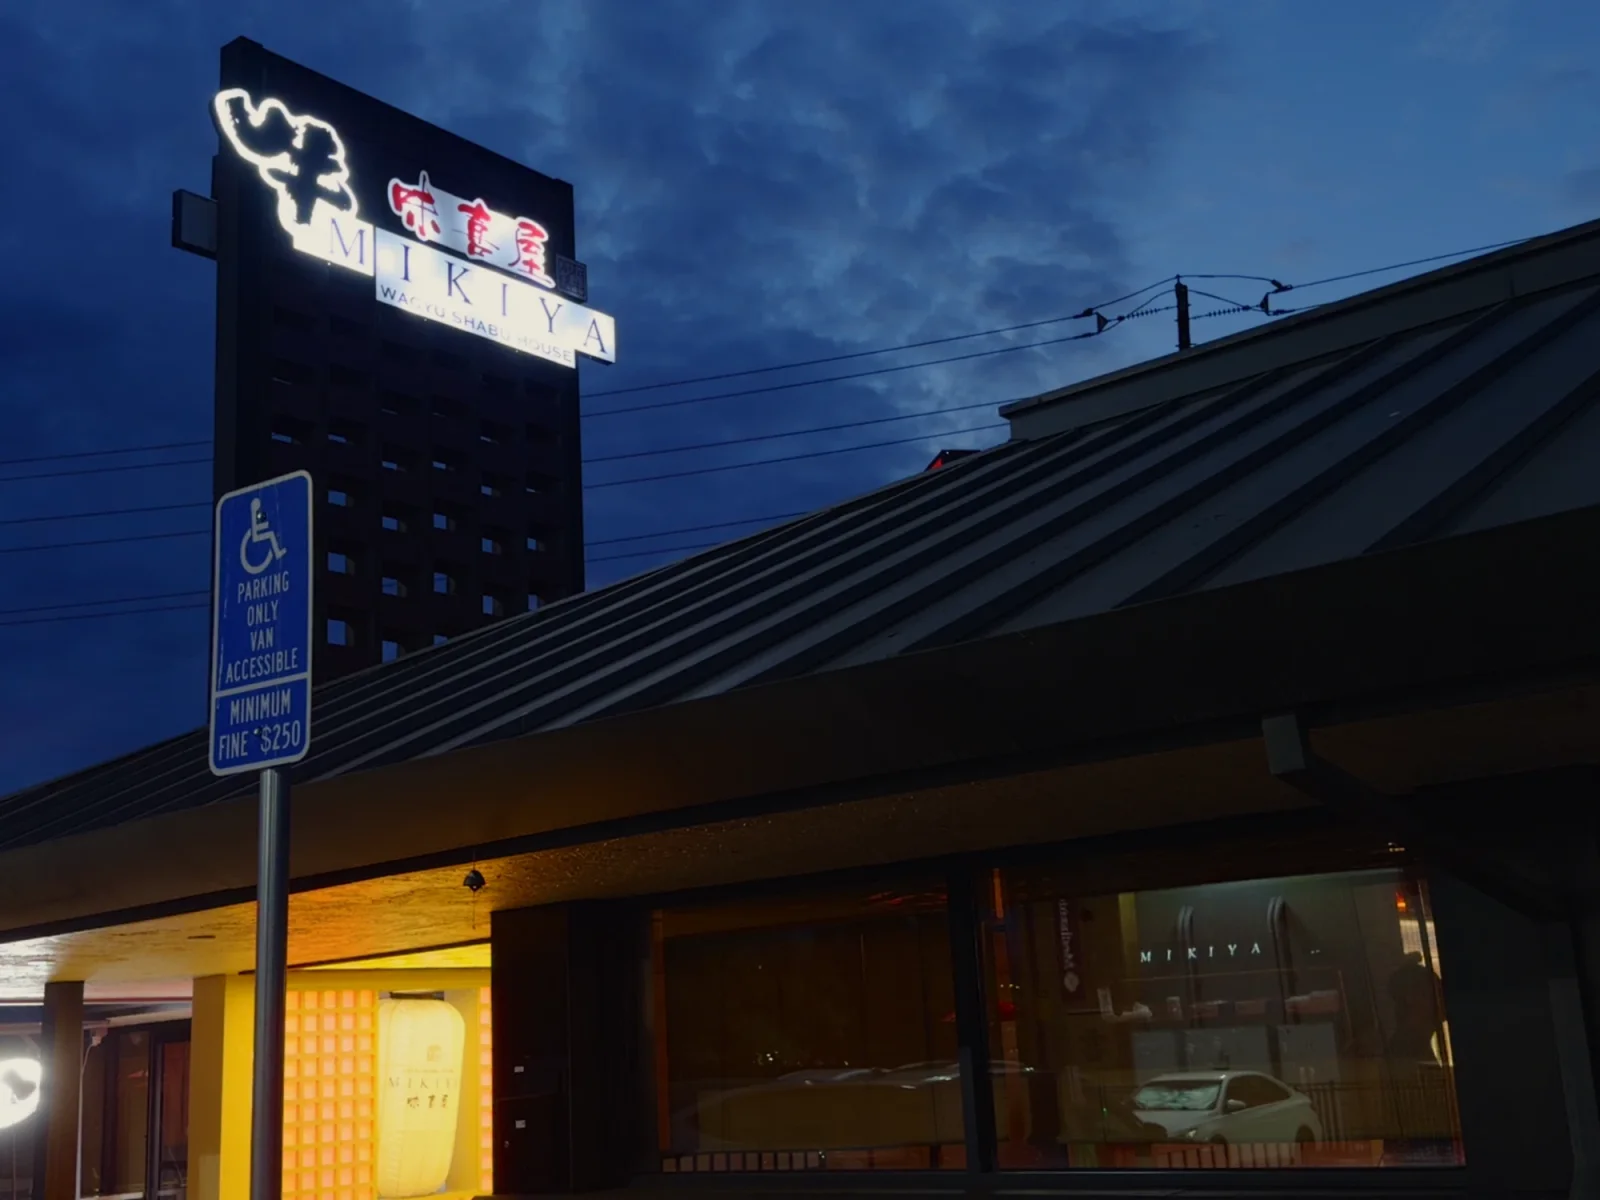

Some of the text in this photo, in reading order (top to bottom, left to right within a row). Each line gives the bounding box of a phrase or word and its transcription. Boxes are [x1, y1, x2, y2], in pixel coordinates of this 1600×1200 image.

[329, 219, 608, 355] MIKIYA
[380, 285, 572, 363] WAGYU SHABU HOUSE
[238, 571, 289, 604] PARKING
[247, 600, 278, 627] ONLY
[250, 627, 274, 652] VAN
[225, 647, 298, 684] ACCESSIBLE
[230, 689, 291, 725] MINIMUM
[219, 719, 301, 761] FINE $250
[1140, 941, 1261, 963] MIKIYA
